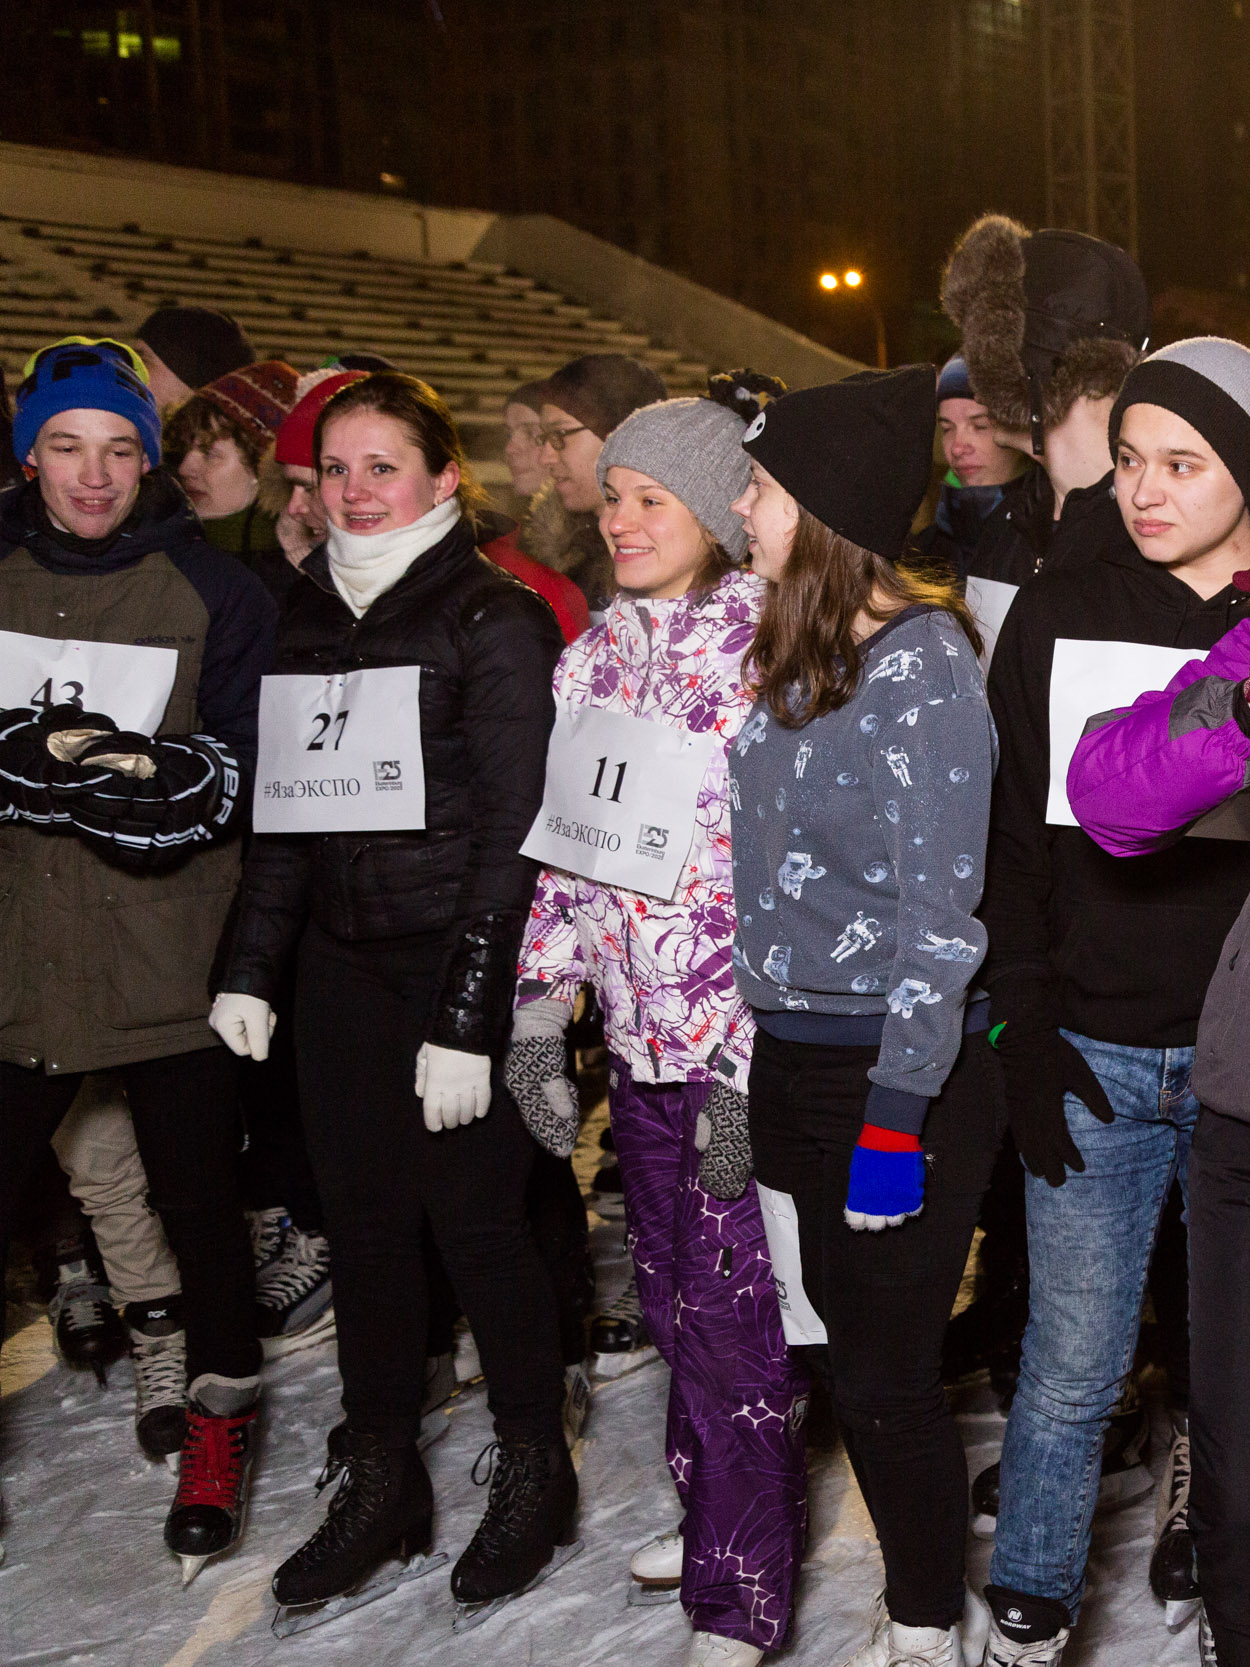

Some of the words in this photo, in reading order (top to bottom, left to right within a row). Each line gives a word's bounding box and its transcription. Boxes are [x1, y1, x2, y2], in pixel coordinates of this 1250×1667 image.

[306, 710, 350, 751] 27
[264, 777, 361, 800] #ЯзаЭКСПО
[588, 755, 628, 804] 11
[546, 815, 621, 852] #ЯзаЭКСПО
[1000, 1618, 1032, 1630] NORDWAY
